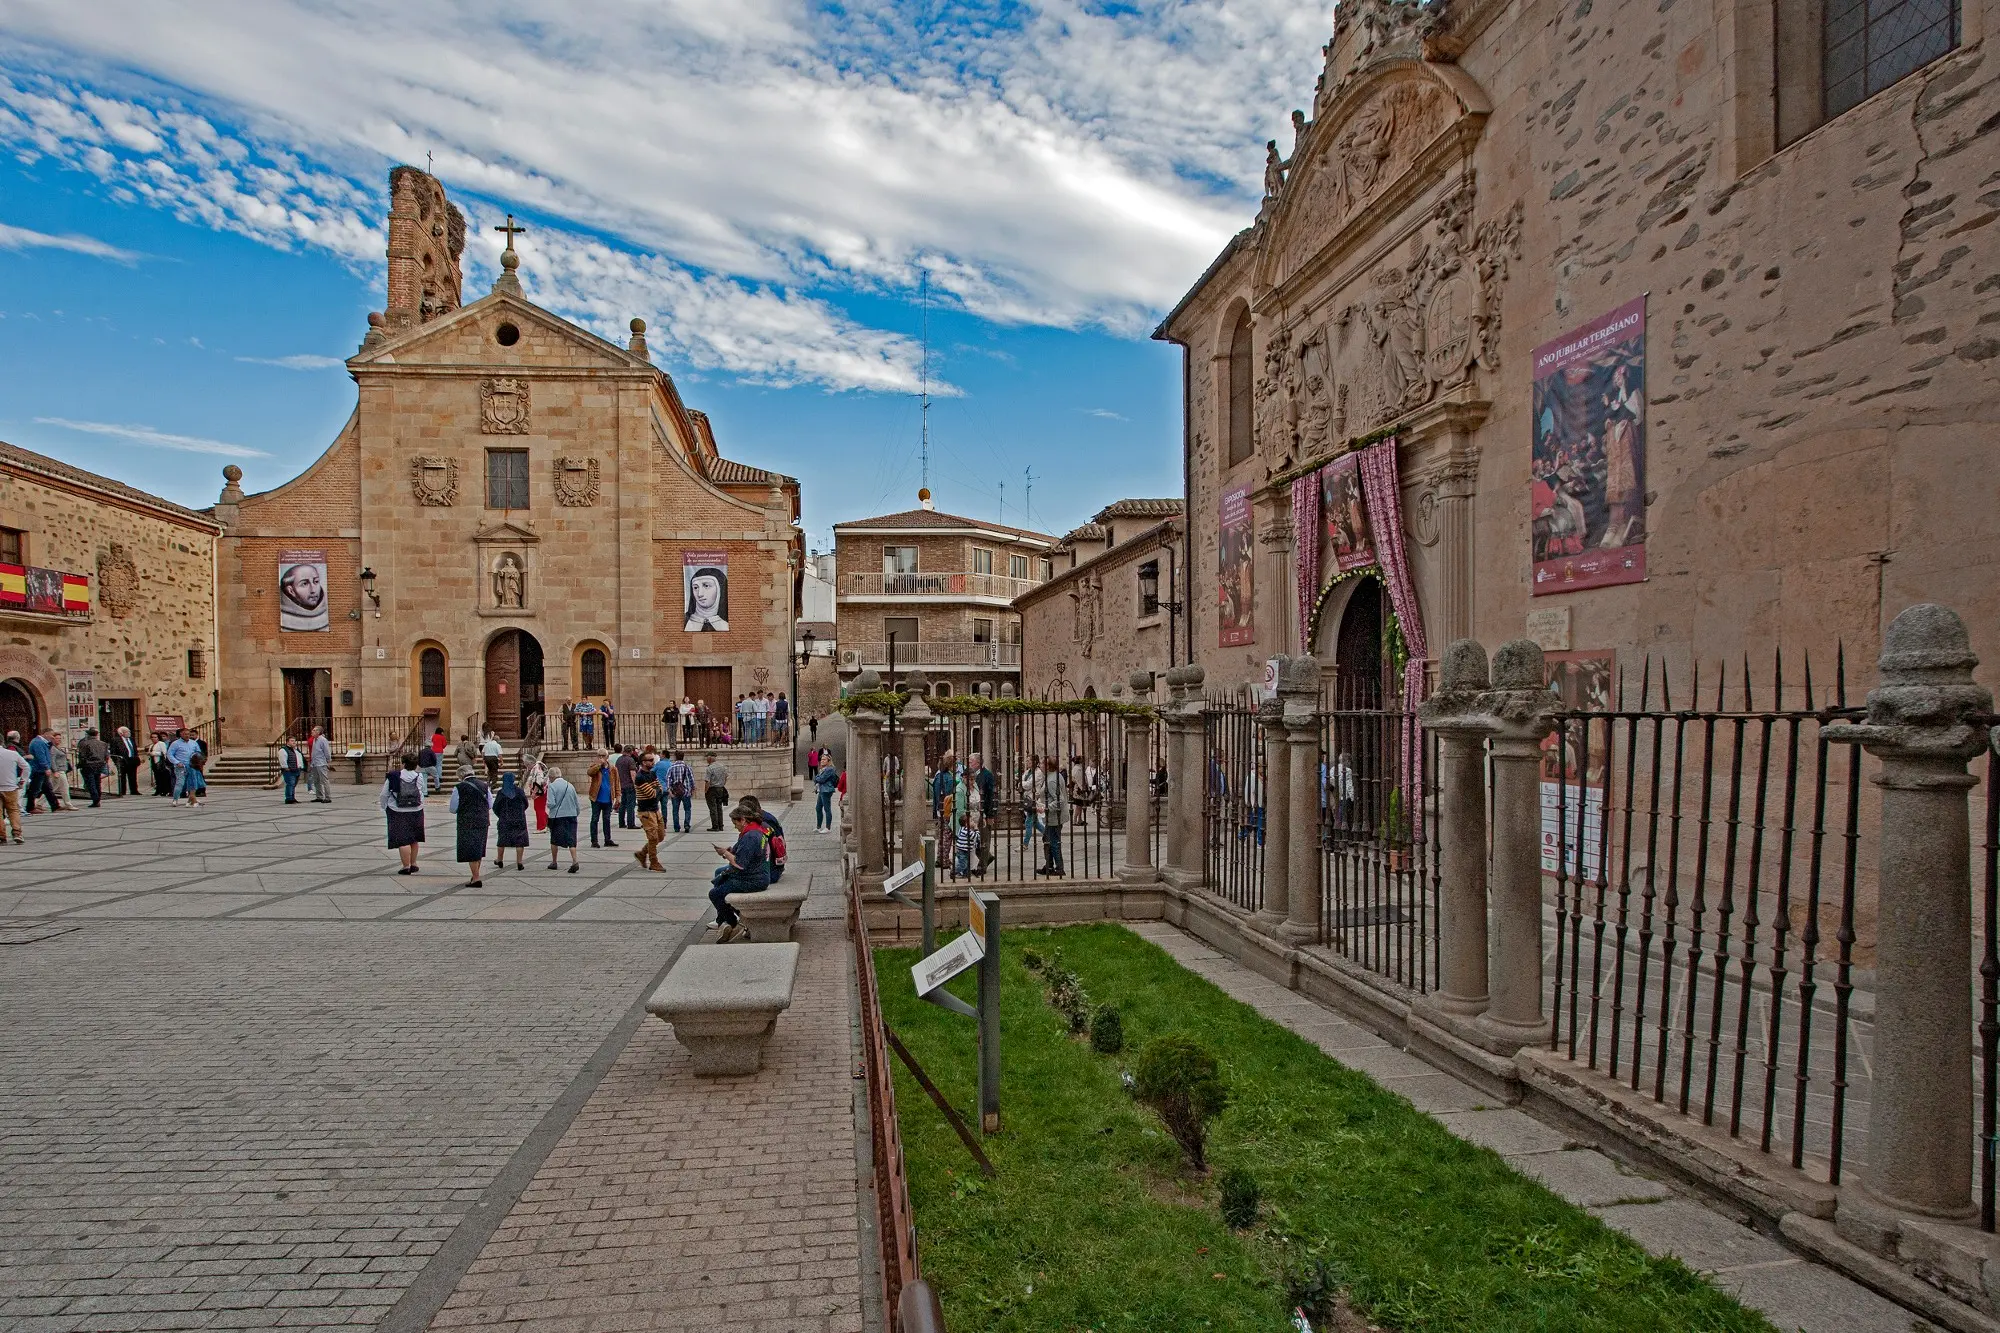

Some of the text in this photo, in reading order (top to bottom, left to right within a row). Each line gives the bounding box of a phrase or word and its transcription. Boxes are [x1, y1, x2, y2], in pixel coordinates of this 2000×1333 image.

[1537, 313, 1639, 369] AÑO JUBILAR TERESIANO
